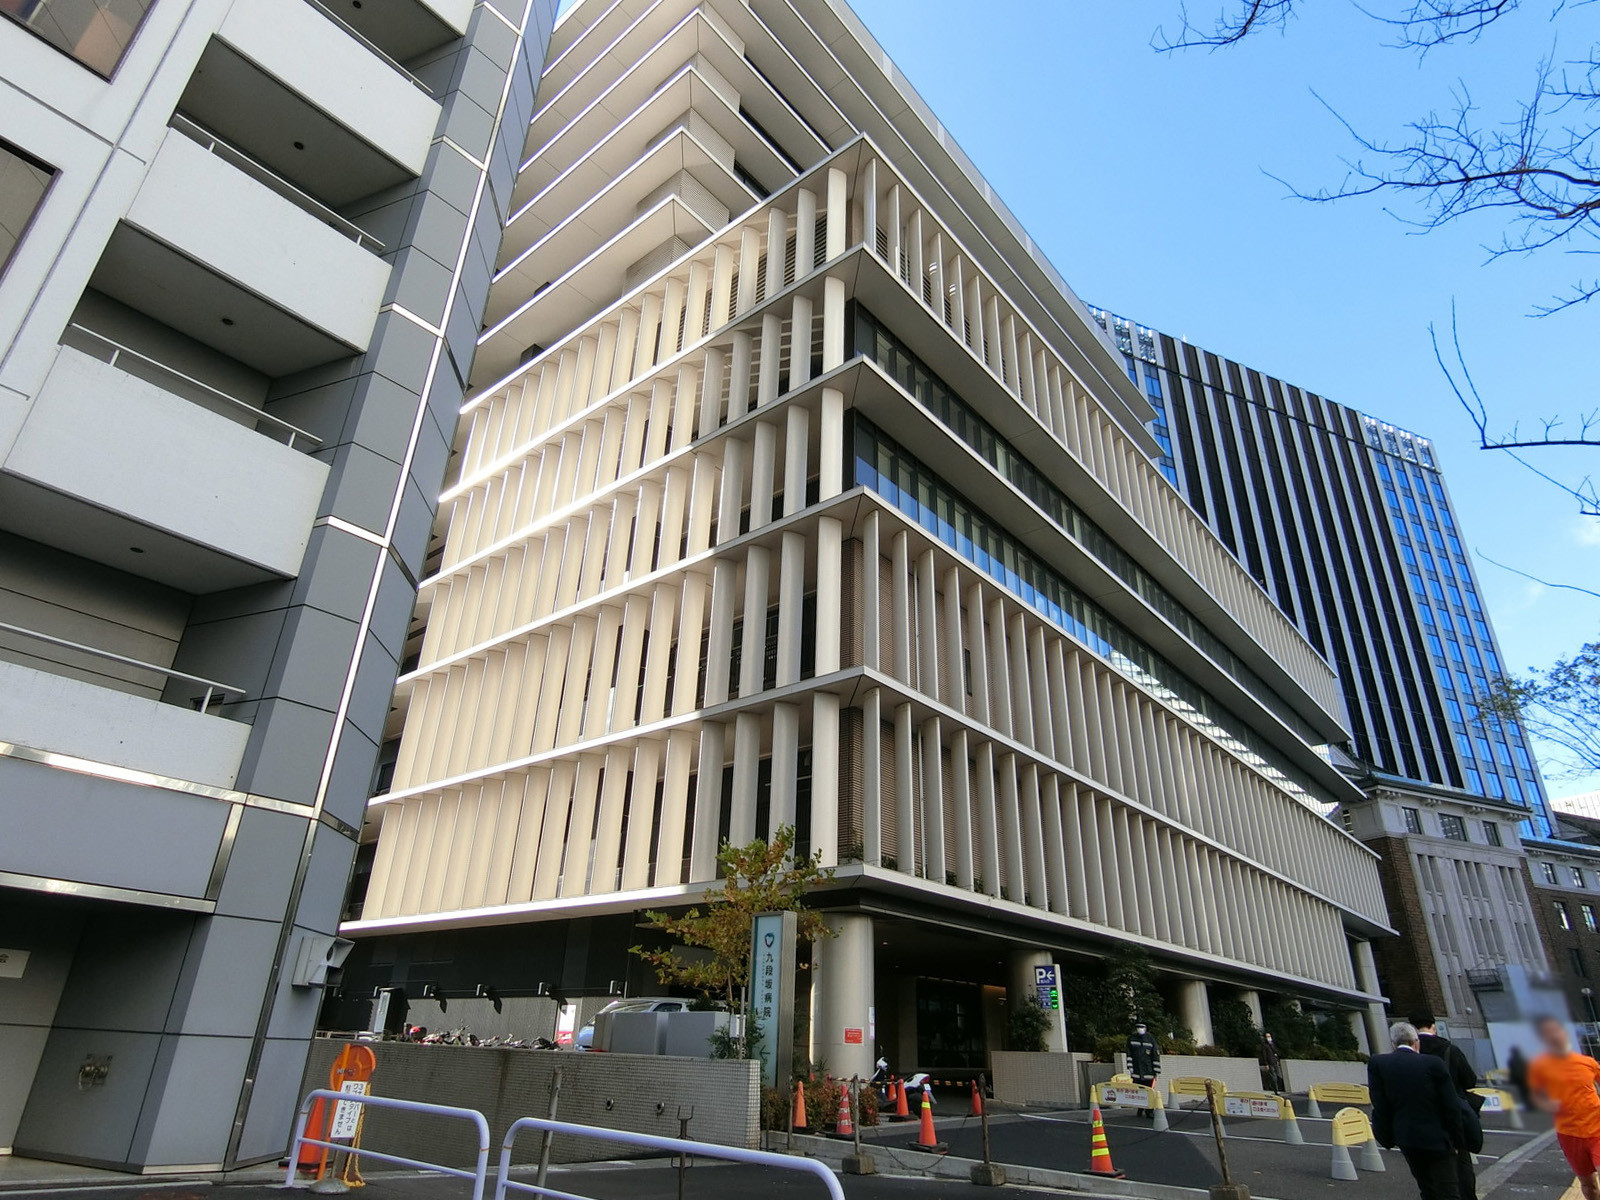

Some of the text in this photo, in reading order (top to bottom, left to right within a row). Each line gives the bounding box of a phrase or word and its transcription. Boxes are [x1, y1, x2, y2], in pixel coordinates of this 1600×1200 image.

[764, 952, 773, 1017] 九段坂病院
[1036, 968, 1046, 983] P
[346, 1083, 359, 1131] ワイタイプは
[351, 1083, 364, 1123] 3ナバーと
